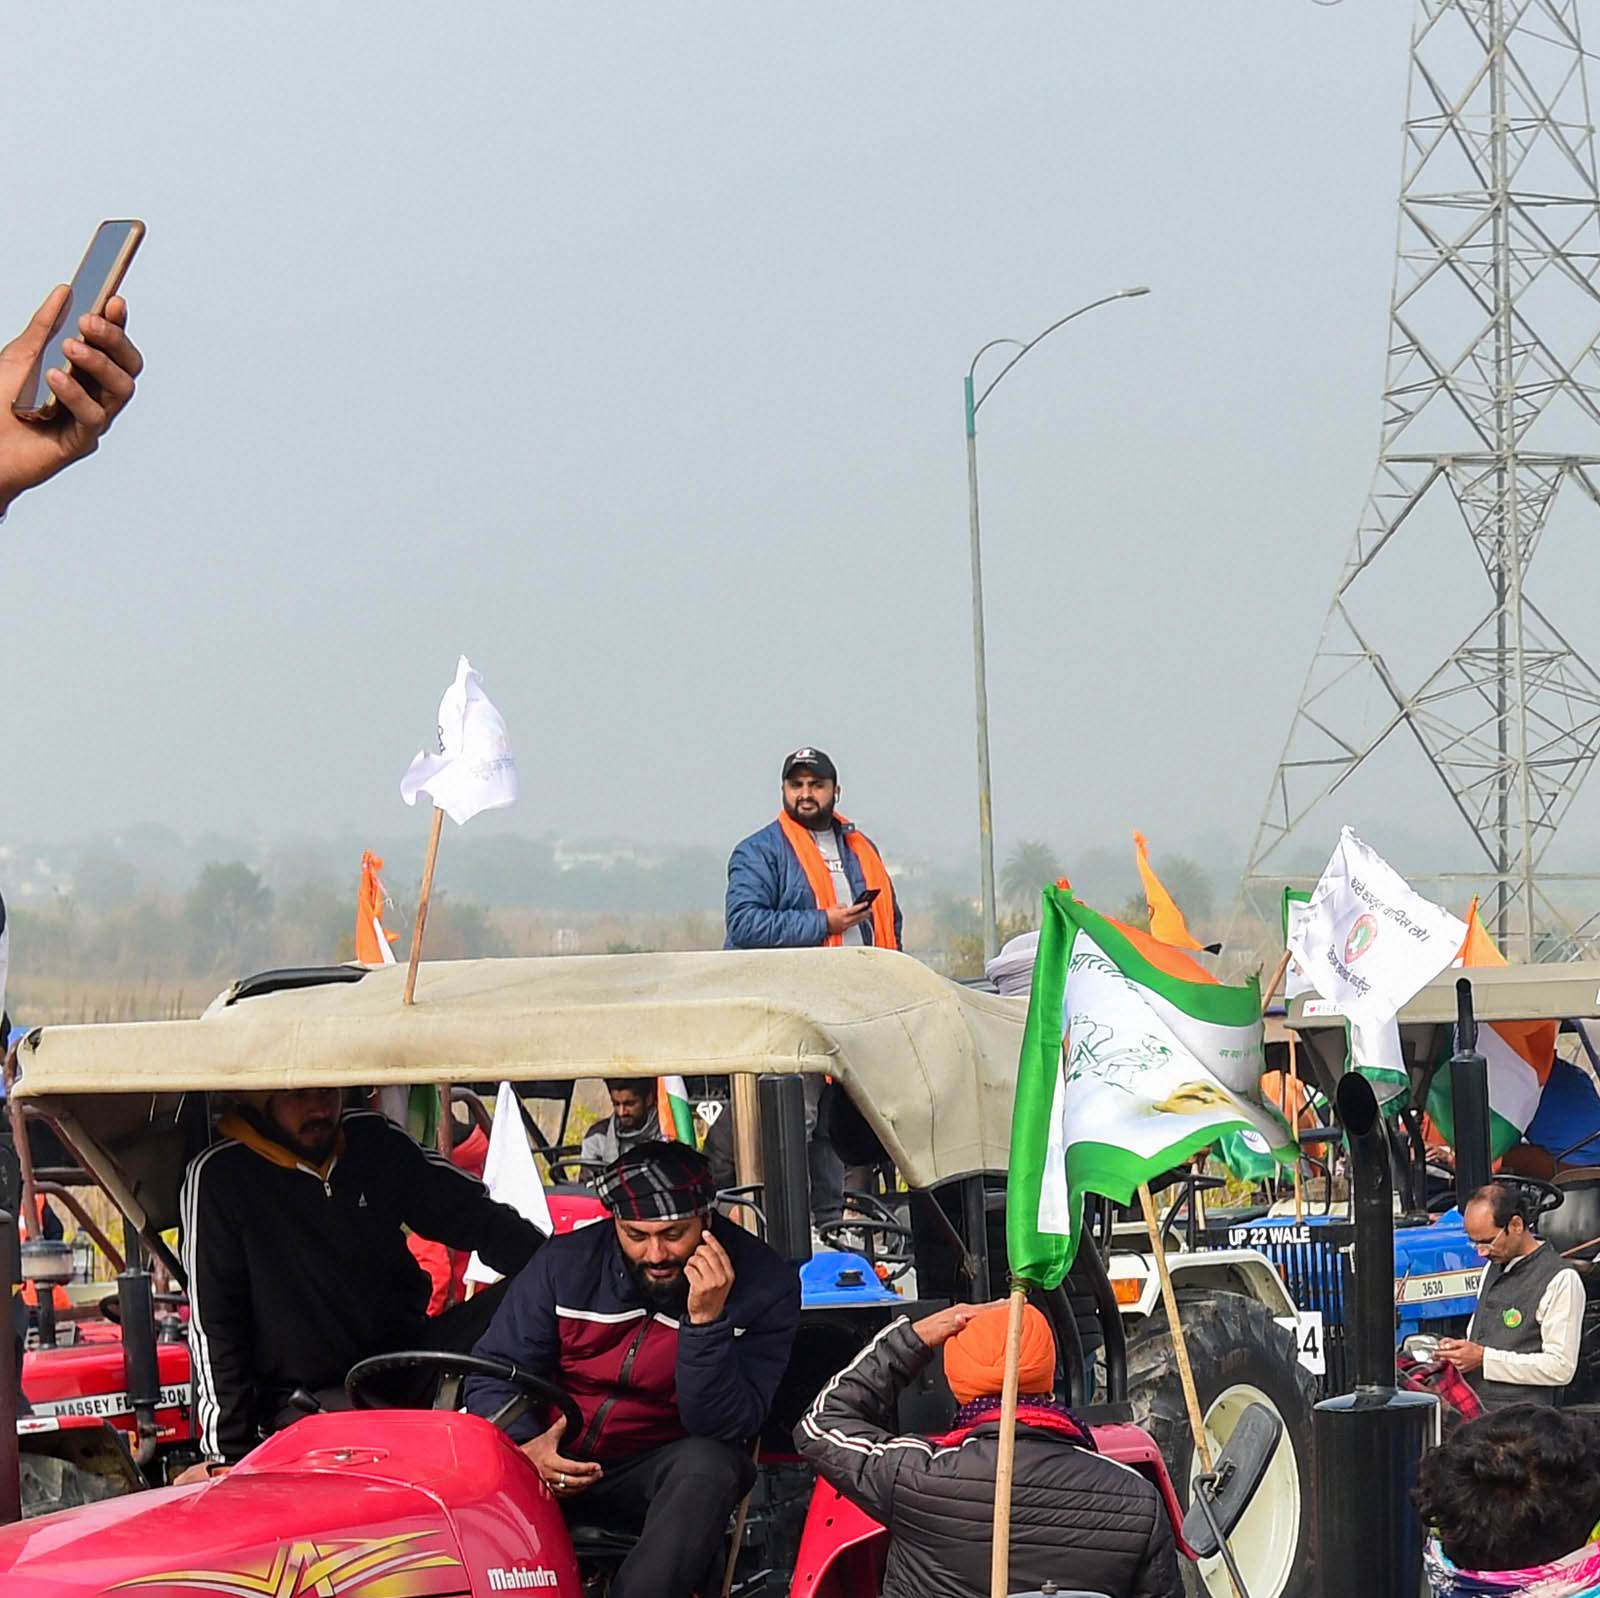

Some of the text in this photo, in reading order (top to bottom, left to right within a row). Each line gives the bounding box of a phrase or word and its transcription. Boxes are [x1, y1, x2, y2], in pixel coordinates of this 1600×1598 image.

[1228, 1226, 1311, 1246] UP 22 WALE
[1422, 1279, 1444, 1297] 3630
[54, 1399, 111, 1417] MASSEY
[487, 1565, 559, 1591] Mahindra
